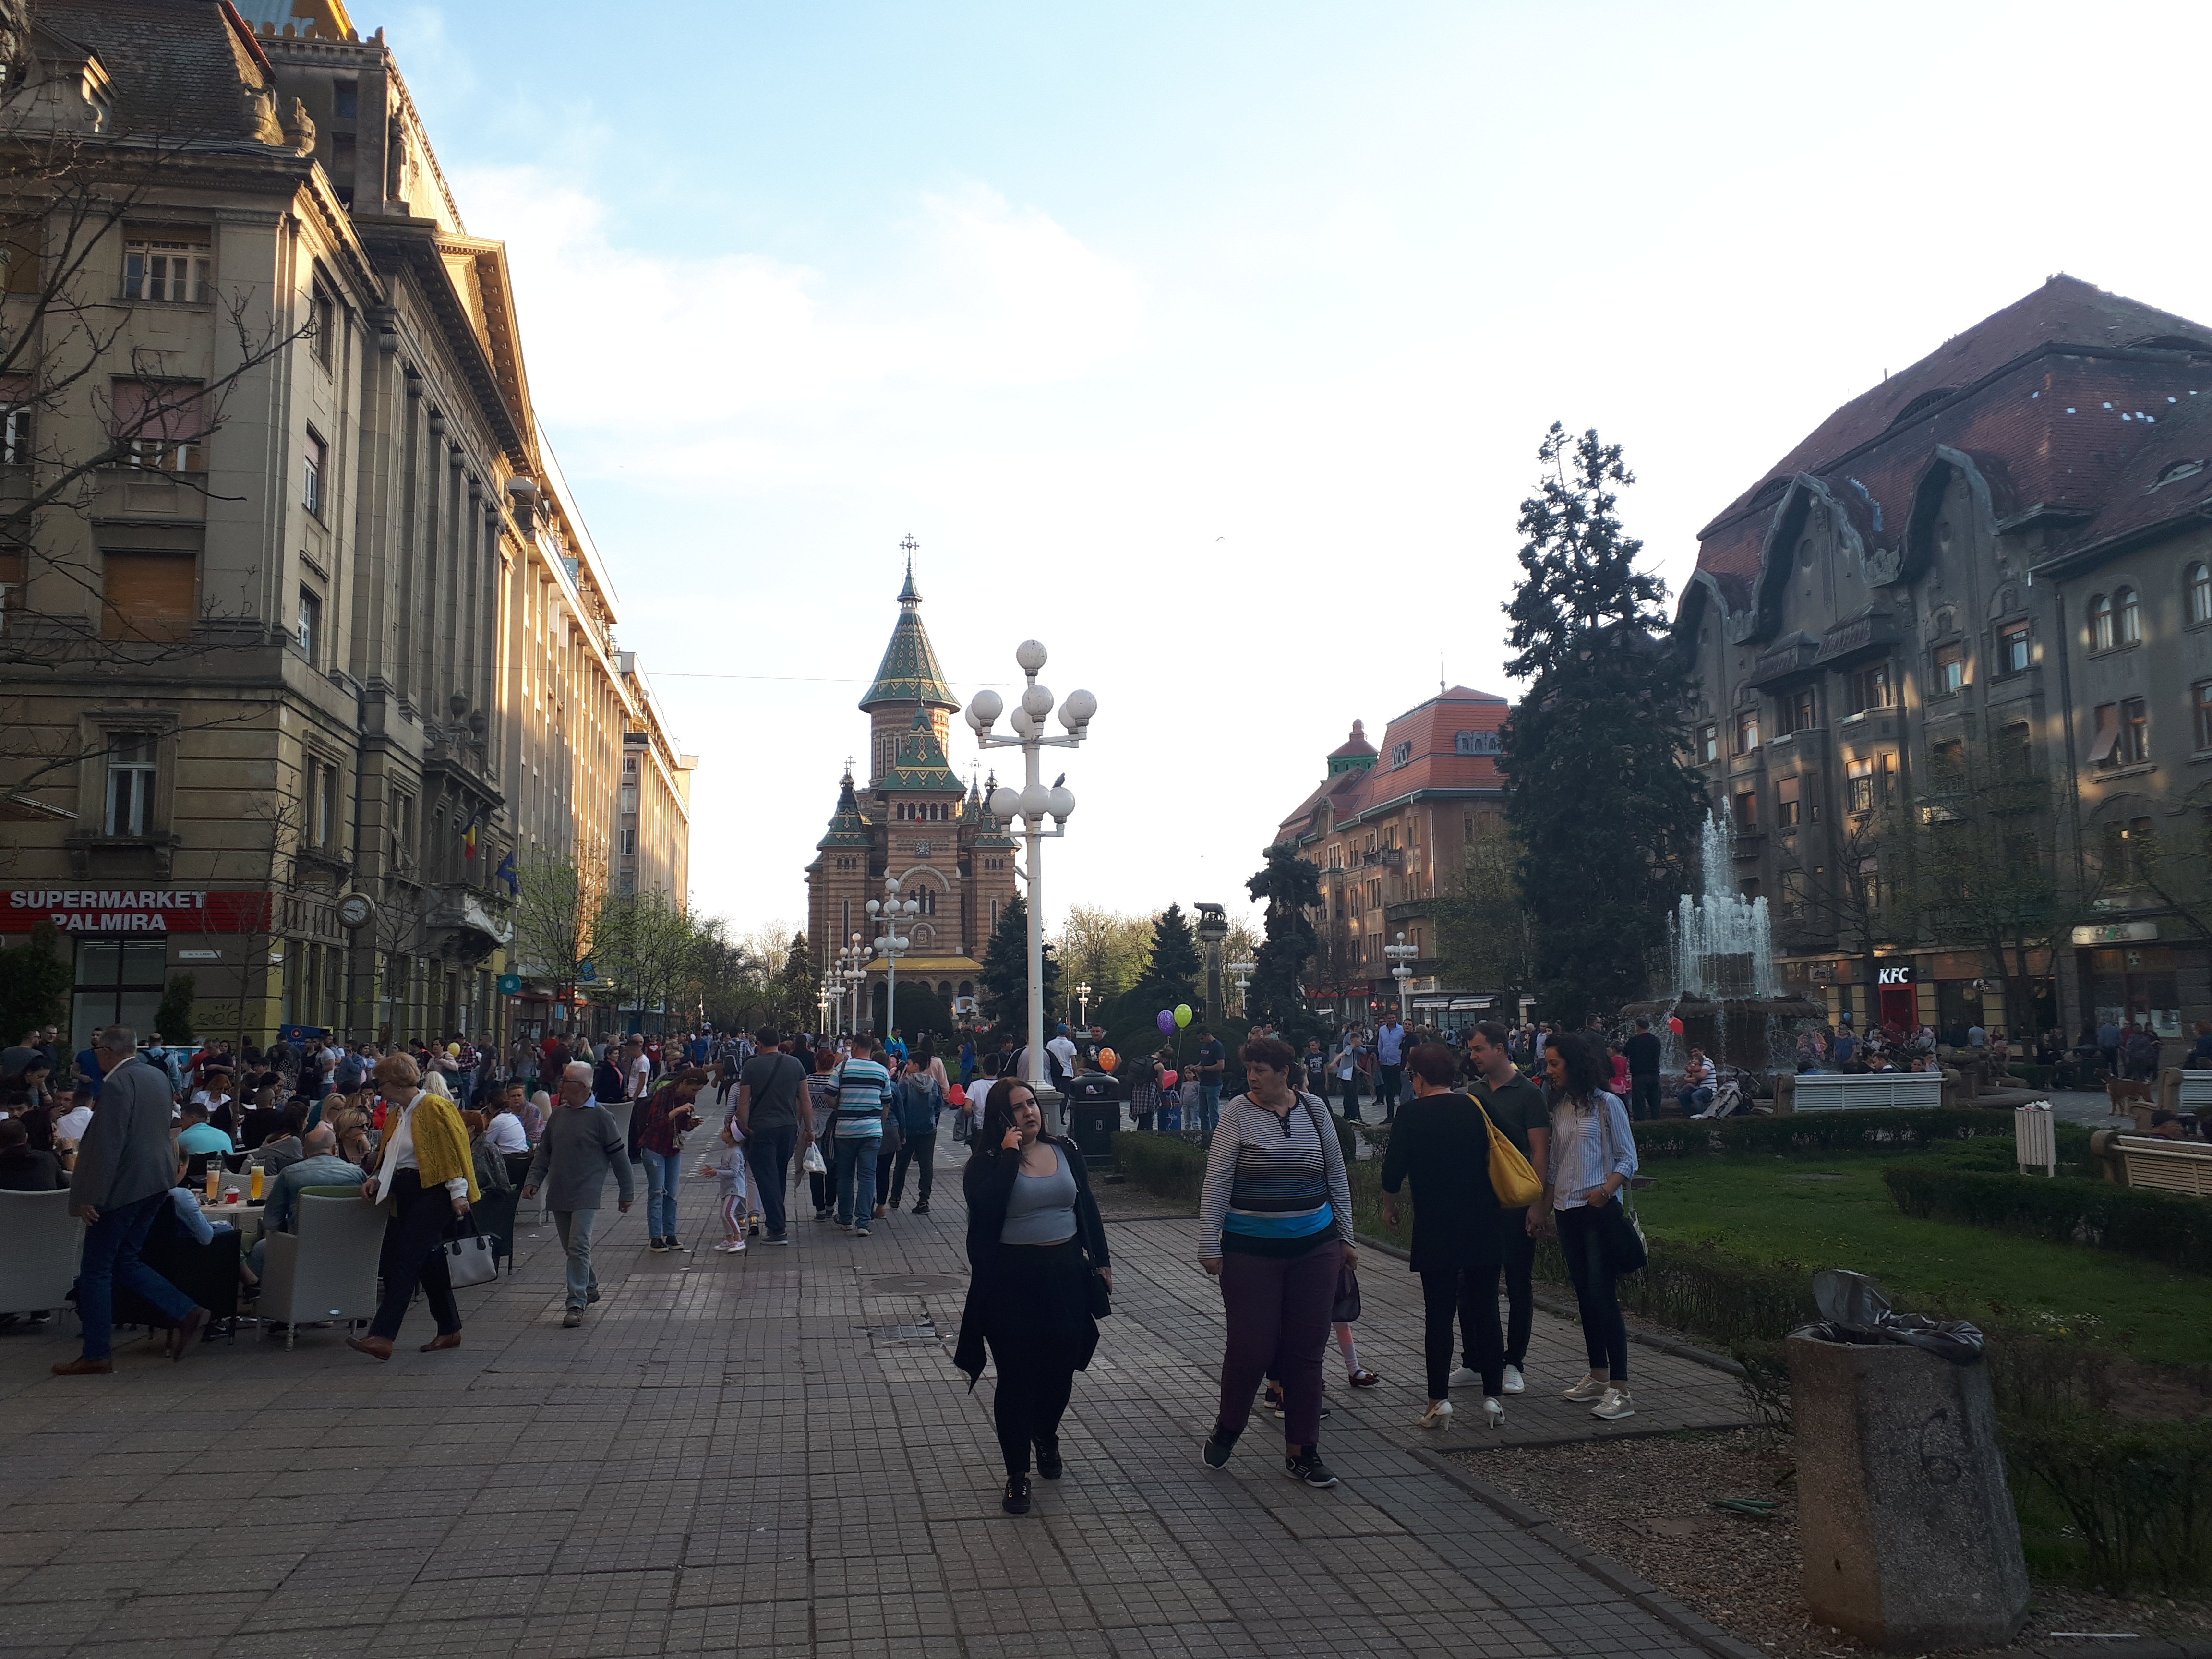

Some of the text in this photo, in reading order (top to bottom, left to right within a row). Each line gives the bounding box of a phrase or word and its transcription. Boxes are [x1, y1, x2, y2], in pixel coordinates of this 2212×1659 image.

[10, 891, 205, 908] SUPERMARKET
[51, 914, 166, 930] PALMIRA
[1878, 967, 1910, 984] KFC
